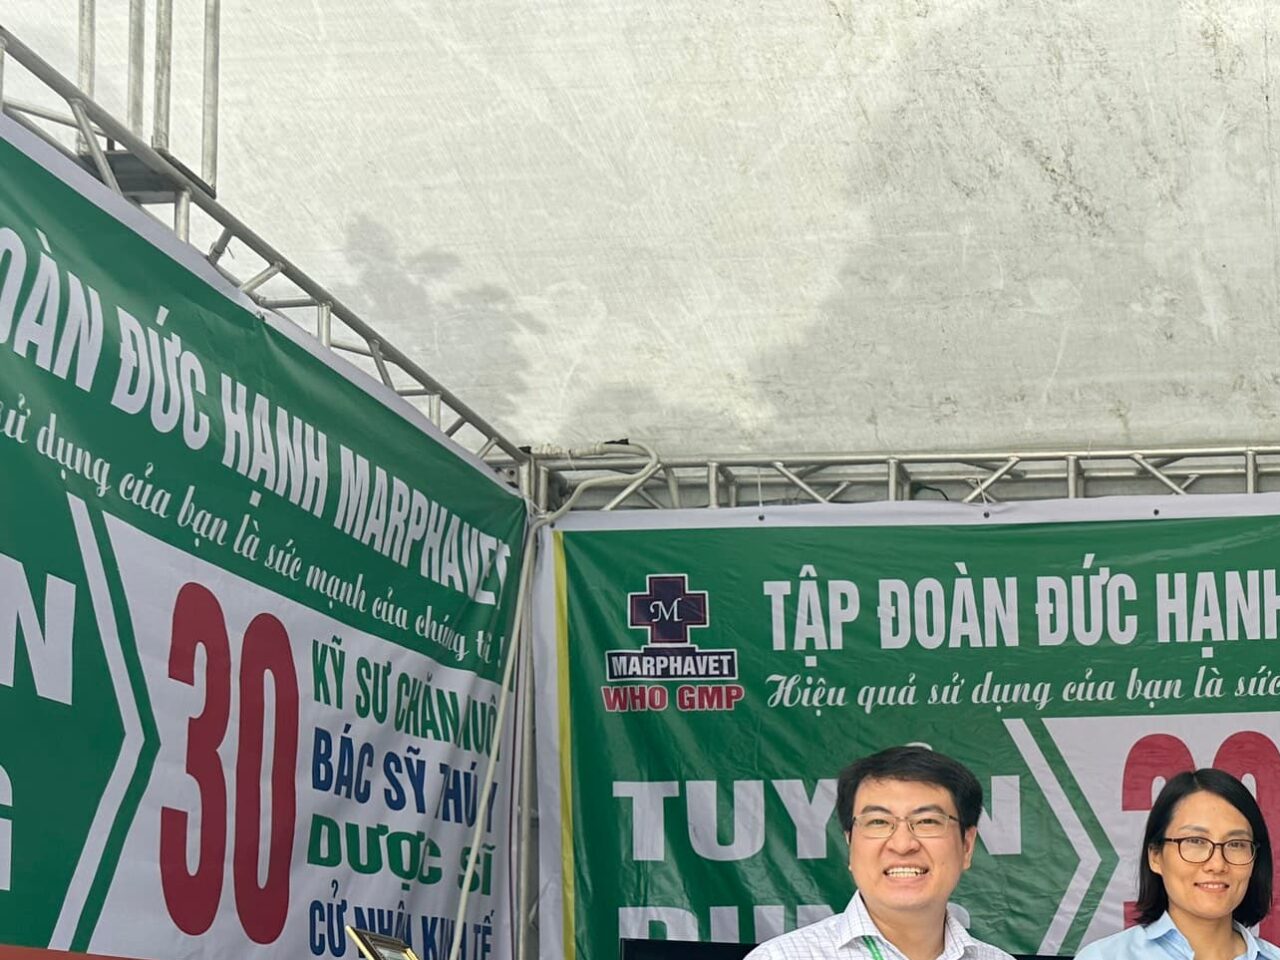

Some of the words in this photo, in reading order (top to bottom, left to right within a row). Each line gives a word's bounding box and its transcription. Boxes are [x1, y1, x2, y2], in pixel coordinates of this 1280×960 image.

[111, 305, 210, 450] ĐỨC
[220, 372, 328, 519] HẠNH
[333, 444, 511, 610] MARPHAVET
[36, 412, 111, 497] dụng
[118, 461, 172, 518] của
[178, 485, 229, 548] bạn
[233, 512, 263, 562] là
[264, 534, 303, 582] sức
[305, 564, 367, 613] mạnh
[371, 585, 410, 632] của
[414, 605, 470, 661] chúng
[763, 565, 860, 667] TẬP
[877, 562, 1020, 649] ĐOÀN
[1035, 553, 1138, 646] ĐỨC
[312, 635, 346, 710] KỸ
[355, 656, 392, 725] SƯ
[394, 671, 462, 747] CHĂN
[601, 684, 669, 712] WHO
[676, 683, 745, 712] GMP
[611, 655, 732, 677] MARPHAVET
[764, 673, 849, 716] Hiệu
[857, 672, 918, 712] quả
[927, 669, 966, 705] sử
[970, 671, 1053, 712] dụng
[1063, 667, 1117, 702] của
[1127, 673, 1184, 708] bạn
[1194, 665, 1226, 698] là
[159, 581, 301, 946] 30
[312, 723, 374, 804] BÁC
[383, 745, 426, 815] SỸ
[435, 761, 478, 828] THÚ
[612, 742, 1022, 861] TUYN
[307, 813, 443, 891] DƯỢC
[309, 878, 348, 958] CỬ
